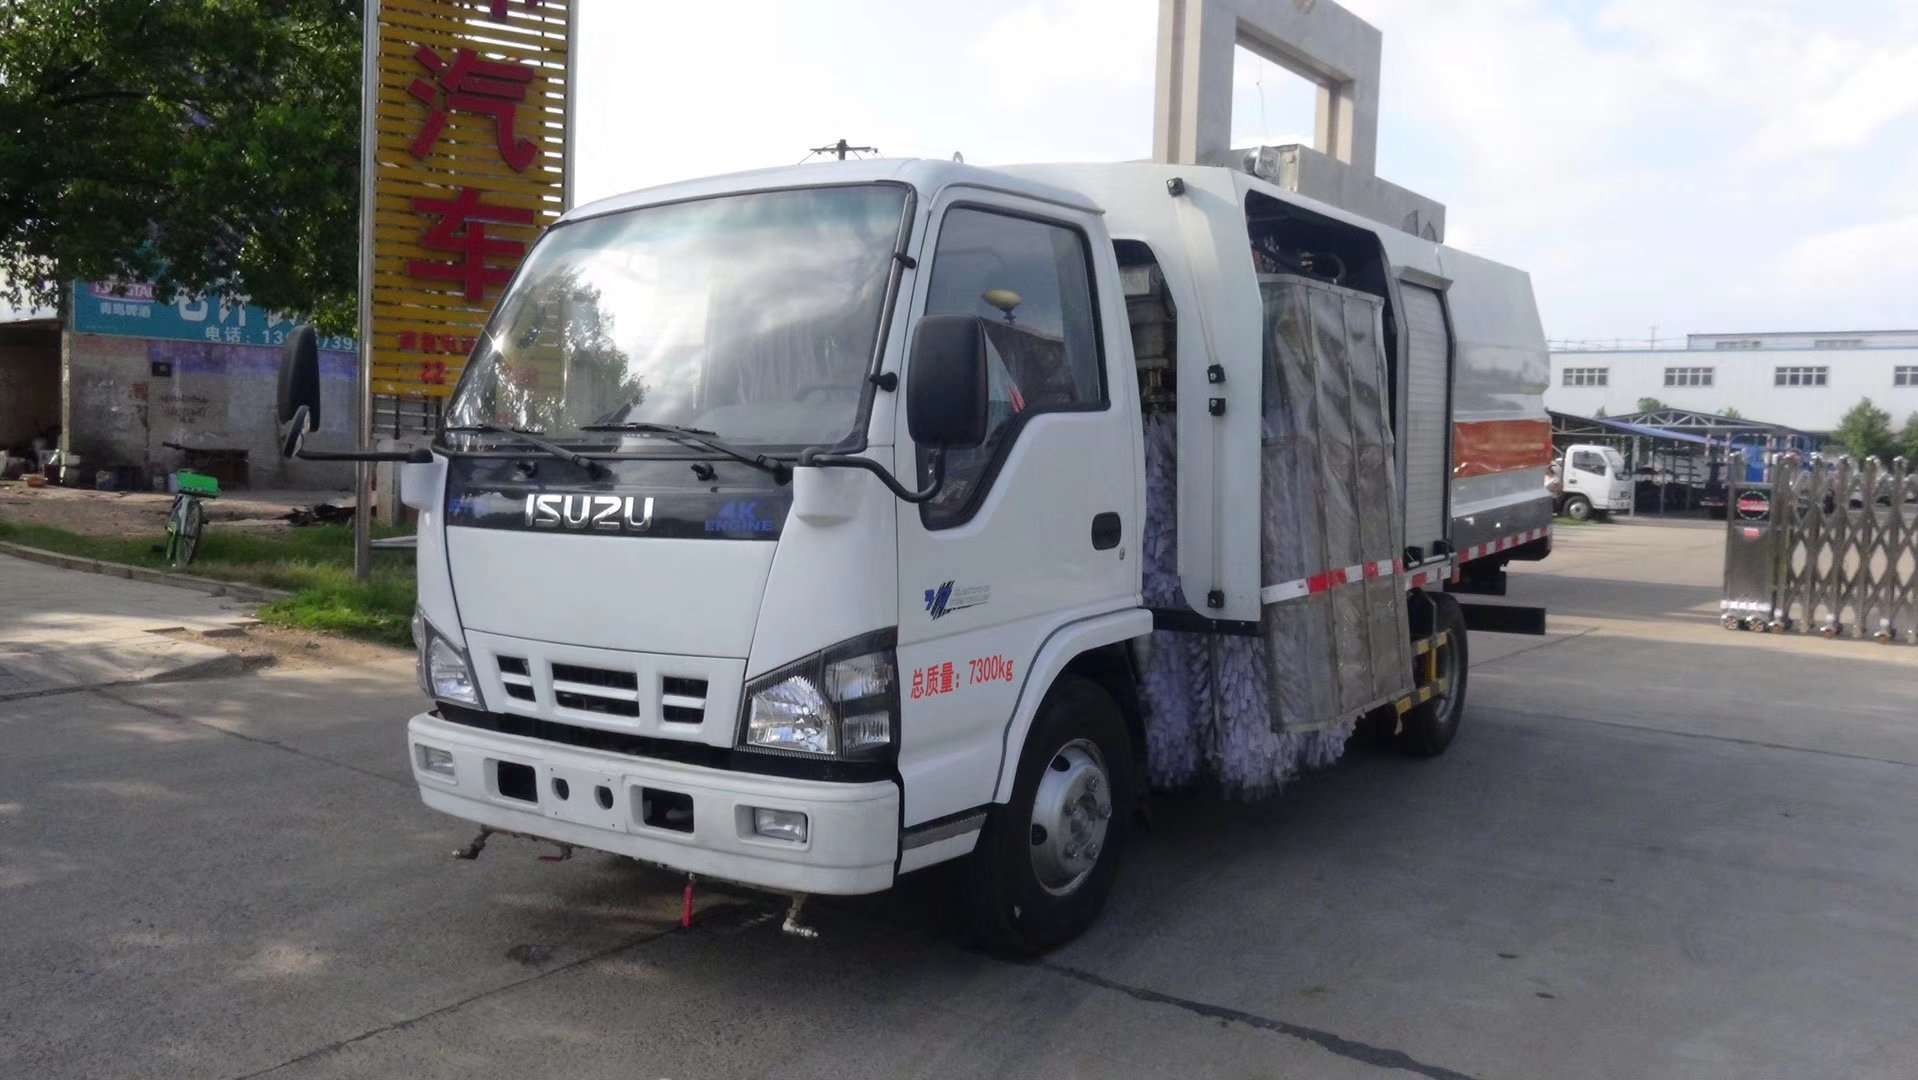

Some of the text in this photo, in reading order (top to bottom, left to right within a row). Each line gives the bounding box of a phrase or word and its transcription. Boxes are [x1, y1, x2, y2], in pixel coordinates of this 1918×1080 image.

[407, 0, 538, 303] 汽车
[525, 493, 654, 532] ISUZU
[704, 519, 774, 532] ENGINE
[911, 655, 1014, 699] 总质量： 7300kg
